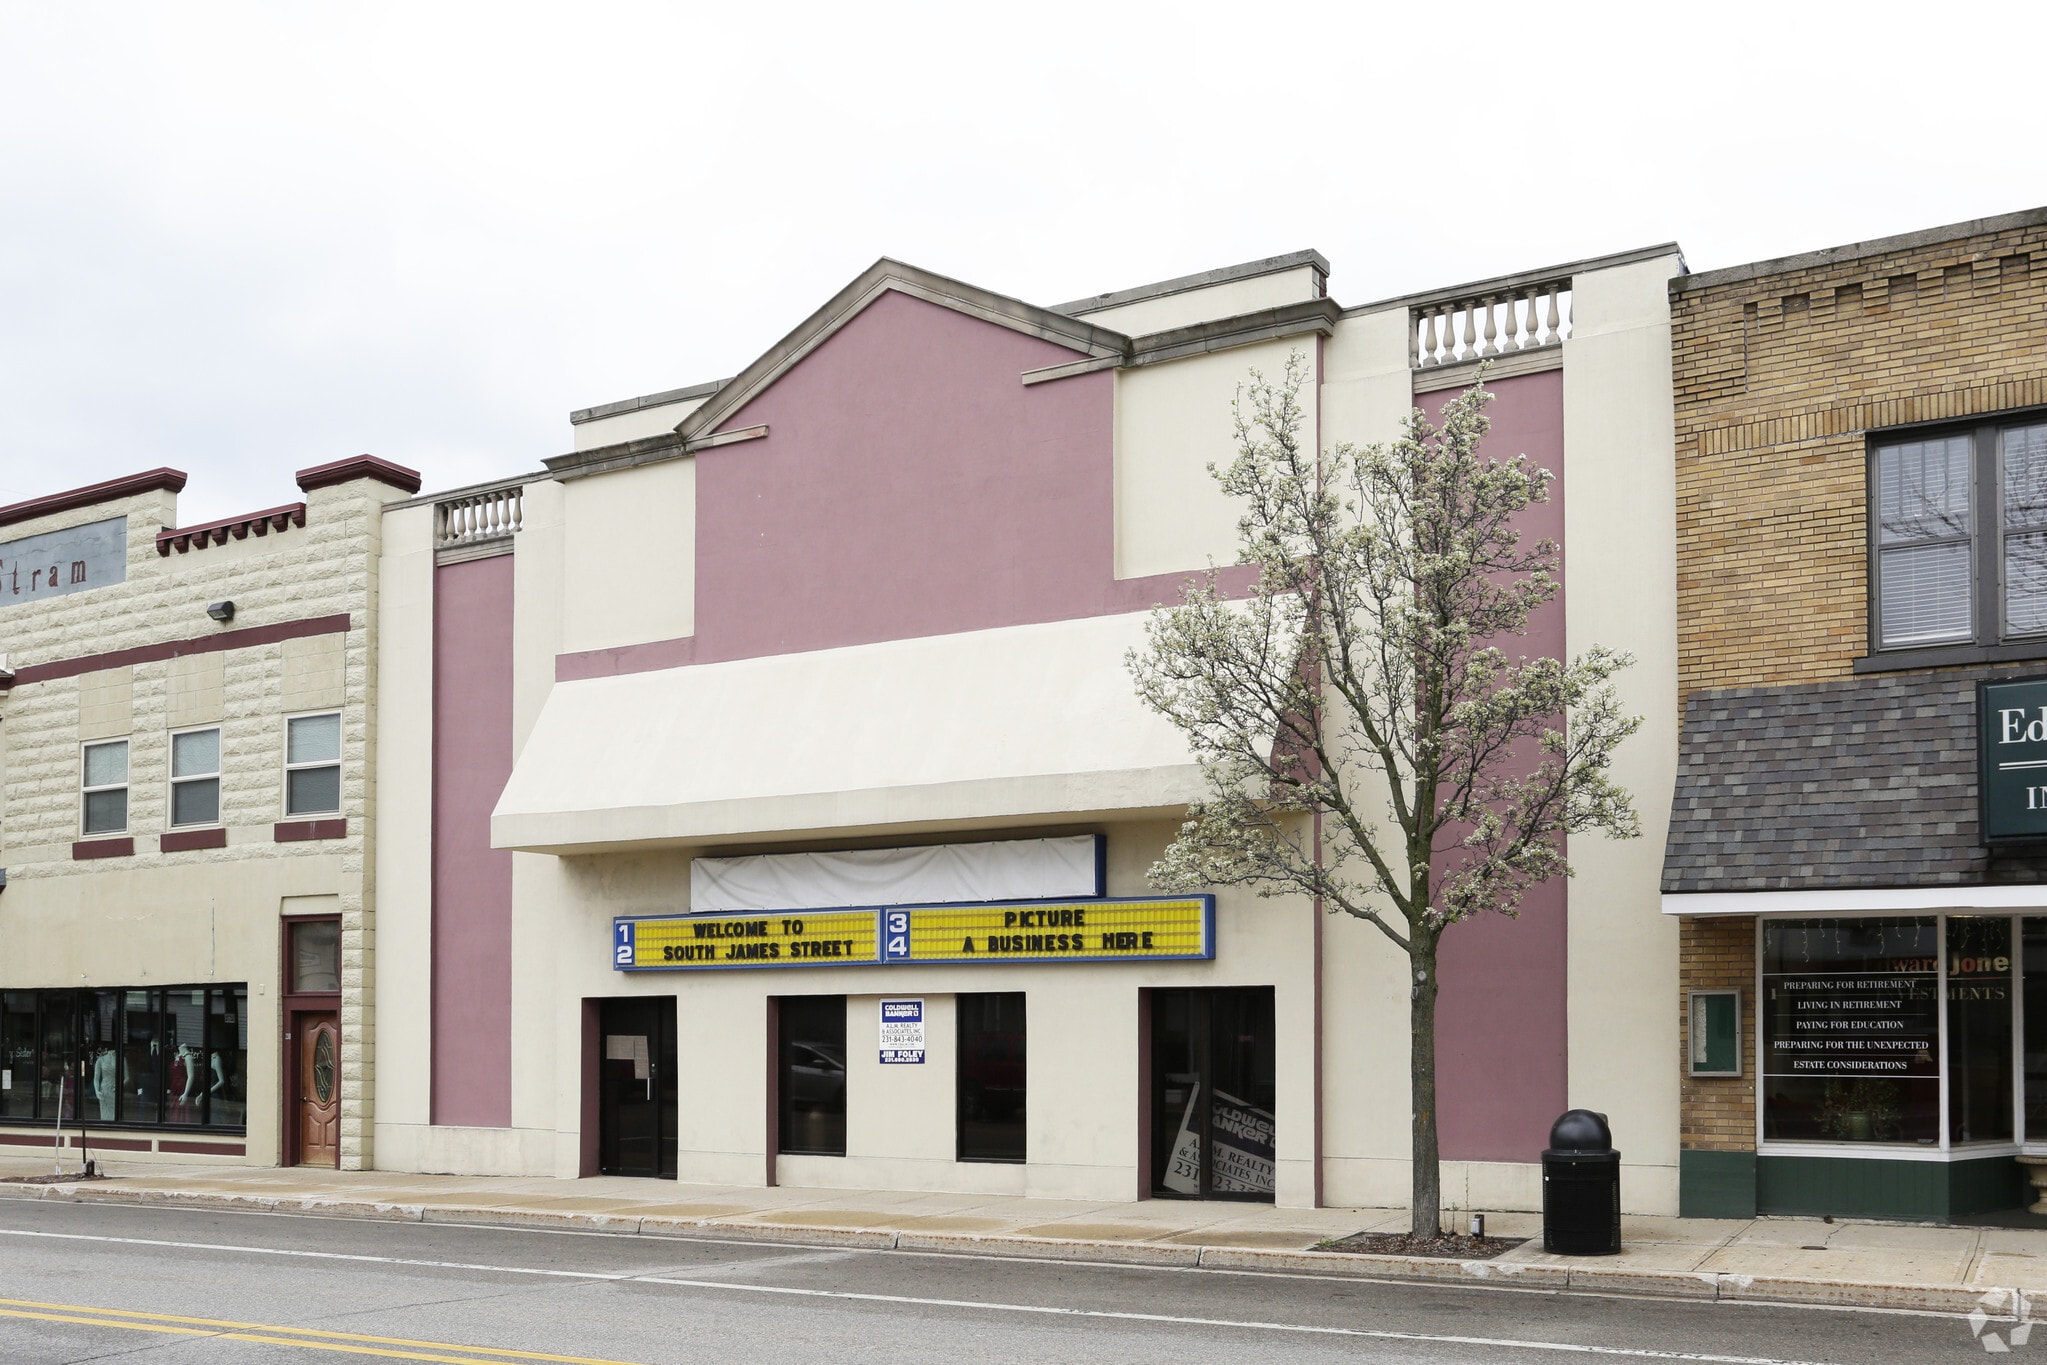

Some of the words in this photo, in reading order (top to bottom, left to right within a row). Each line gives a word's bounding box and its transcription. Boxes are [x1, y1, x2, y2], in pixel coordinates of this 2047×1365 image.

[0, 559, 87, 595] tram
[1998, 706, 2047, 744] Ed
[889, 913, 907, 933] 3
[1005, 909, 1085, 928] PICTURE
[619, 925, 628, 943] 1
[693, 920, 768, 939] WELCOME
[782, 919, 804, 935] TO
[664, 944, 715, 961] SOUTH
[725, 943, 779, 960] JAMES
[791, 940, 853, 957] STREET
[889, 936, 907, 956] 4
[963, 936, 975, 953] A
[988, 934, 1083, 952] BUSINESS
[1102, 931, 1153, 949] HERE
[617, 947, 633, 964] 2
[1949, 951, 2012, 976] Jone
[1784, 981, 1834, 990] PREPARING
[1836, 981, 1855, 989] FOR
[1857, 980, 1917, 989] RETIREMENT
[1798, 1001, 1828, 1010] LIVING
[1830, 1001, 1841, 1009] IN
[1843, 1001, 1902, 1009] RETIREMENT
[1796, 1021, 1828, 1030] PAYING
[1830, 1021, 1849, 1029] FOR
[1851, 1021, 1904, 1029] EDUCATION
[1774, 1041, 1824, 1049] PREPARING
[1825, 1041, 1844, 1049] FOR
[1845, 1041, 1865, 1049] THE
[1867, 1041, 1929, 1049] UNEXPECTED
[1793, 1061, 1825, 1069] ESTATE
[1827, 1061, 1907, 1070] CONSIDERATIONS
[1212, 1115, 1268, 1145] ANKER
[1179, 1147, 1189, 1158] &
[1228, 1152, 1275, 1175] REALTY
